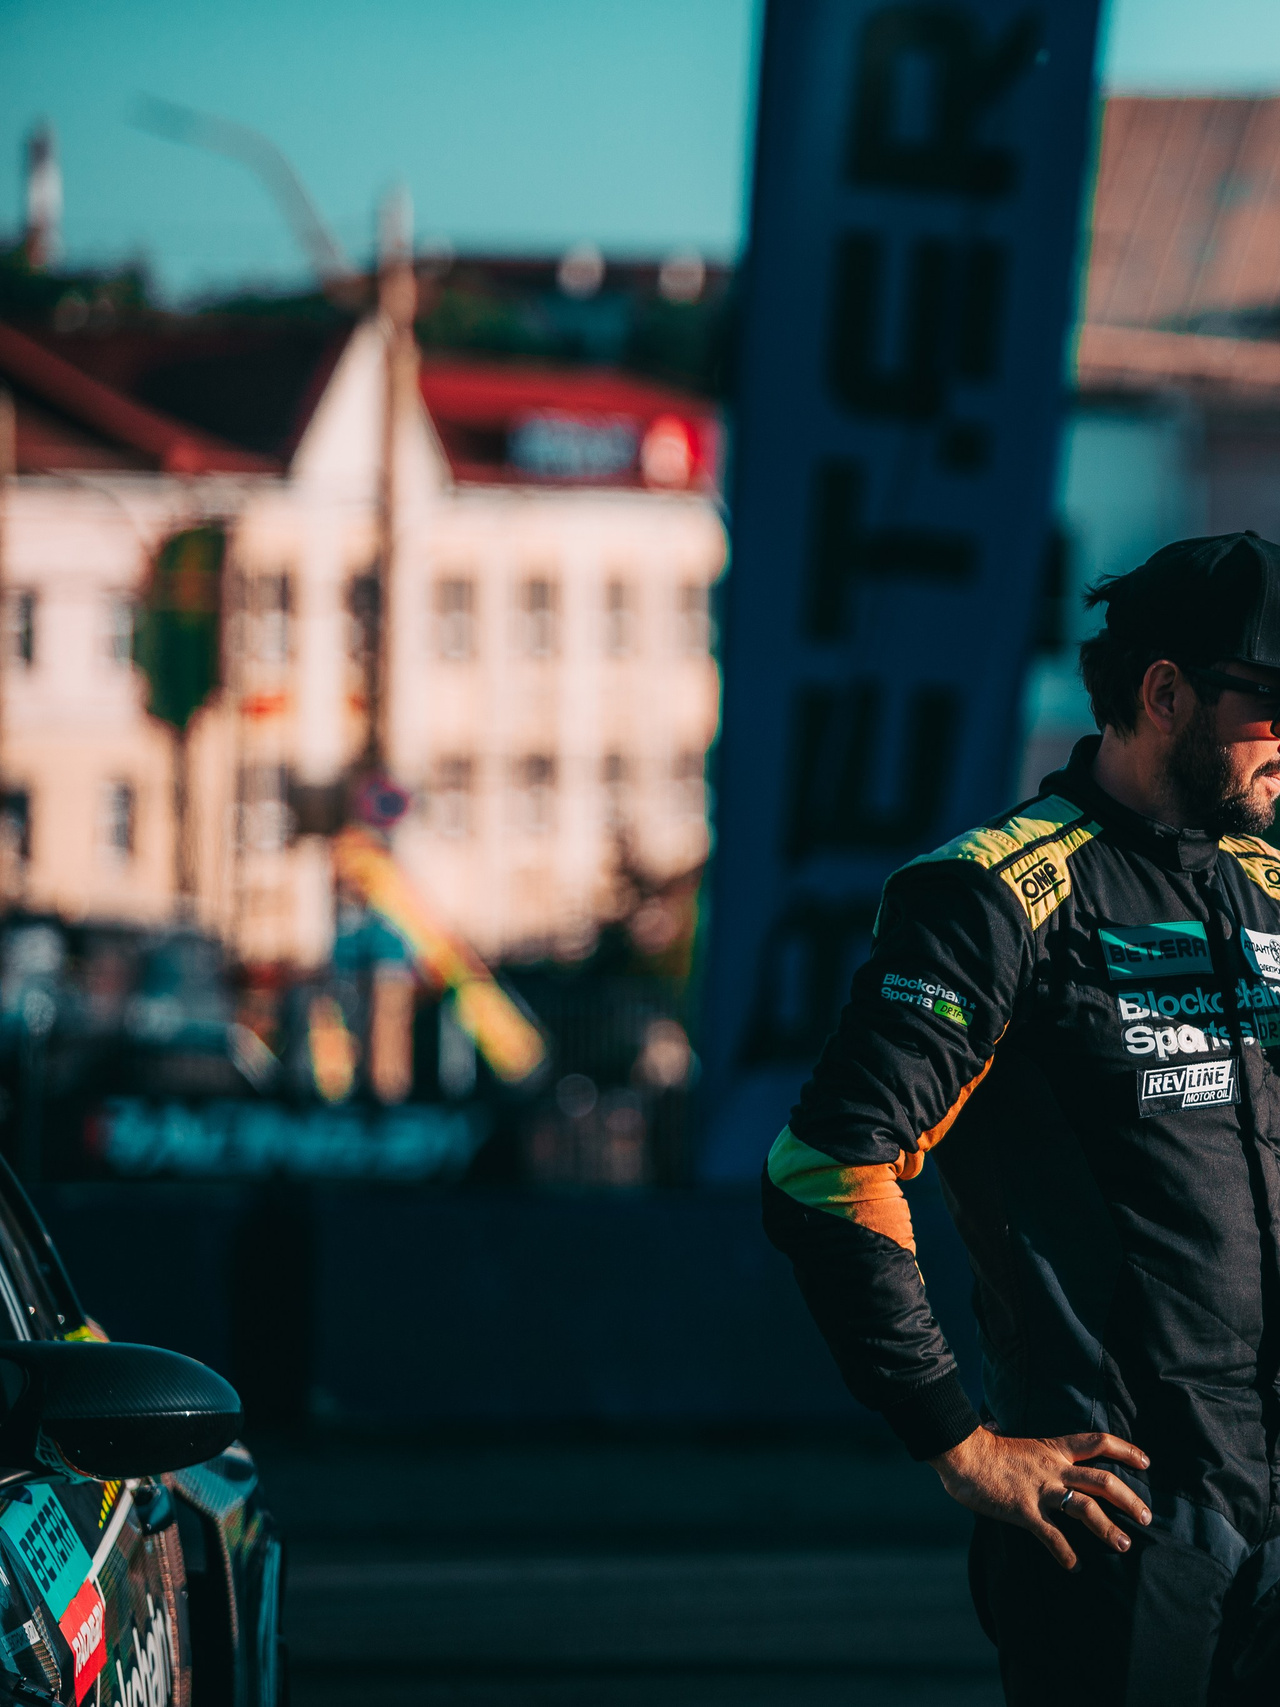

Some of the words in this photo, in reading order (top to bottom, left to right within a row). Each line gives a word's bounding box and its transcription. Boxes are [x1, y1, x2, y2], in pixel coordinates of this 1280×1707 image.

[1021, 862, 1058, 899] OMP
[880, 986, 934, 1010] Sports
[882, 973, 968, 1007] Blockchain
[940, 1004, 969, 1020] DRIFT
[1185, 1090, 1216, 1104] MOTOR
[1216, 1089, 1230, 1101] OIL
